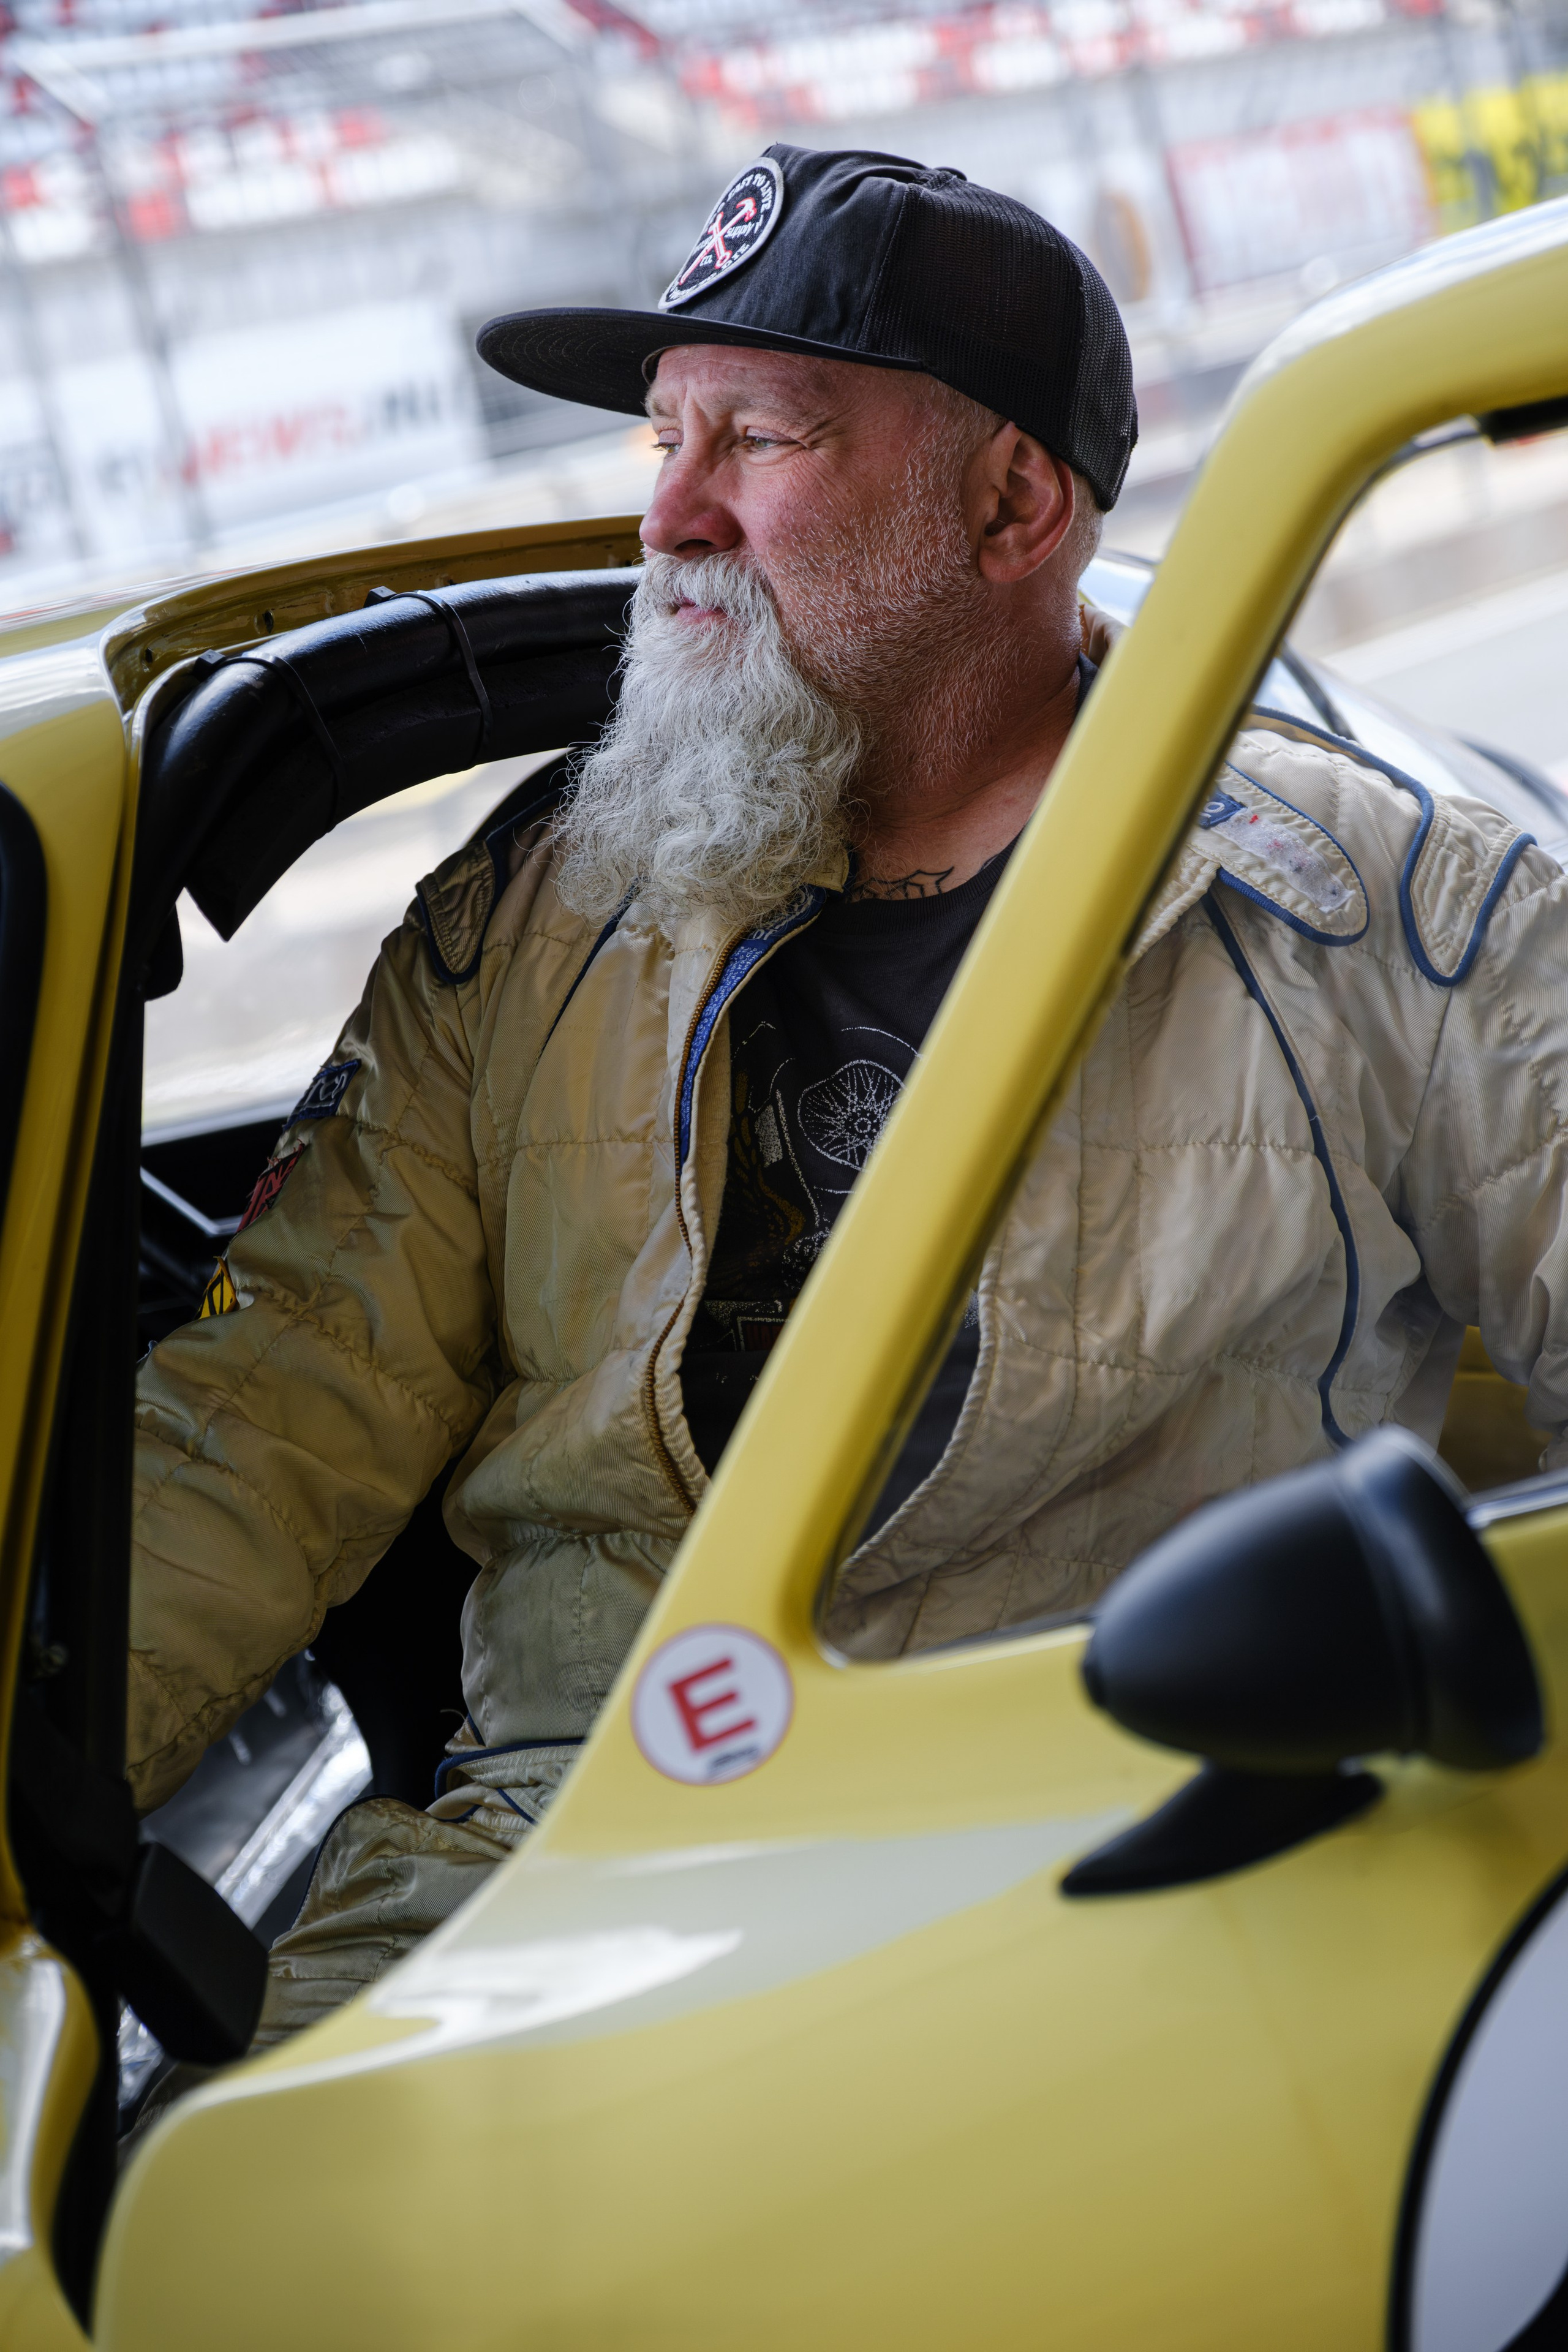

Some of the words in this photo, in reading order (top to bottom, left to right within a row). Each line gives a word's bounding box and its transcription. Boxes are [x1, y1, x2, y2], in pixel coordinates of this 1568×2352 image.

[752, 173, 767, 187] TO
[760, 180, 773, 214] LIVE
[668, 1656, 756, 1753] E
